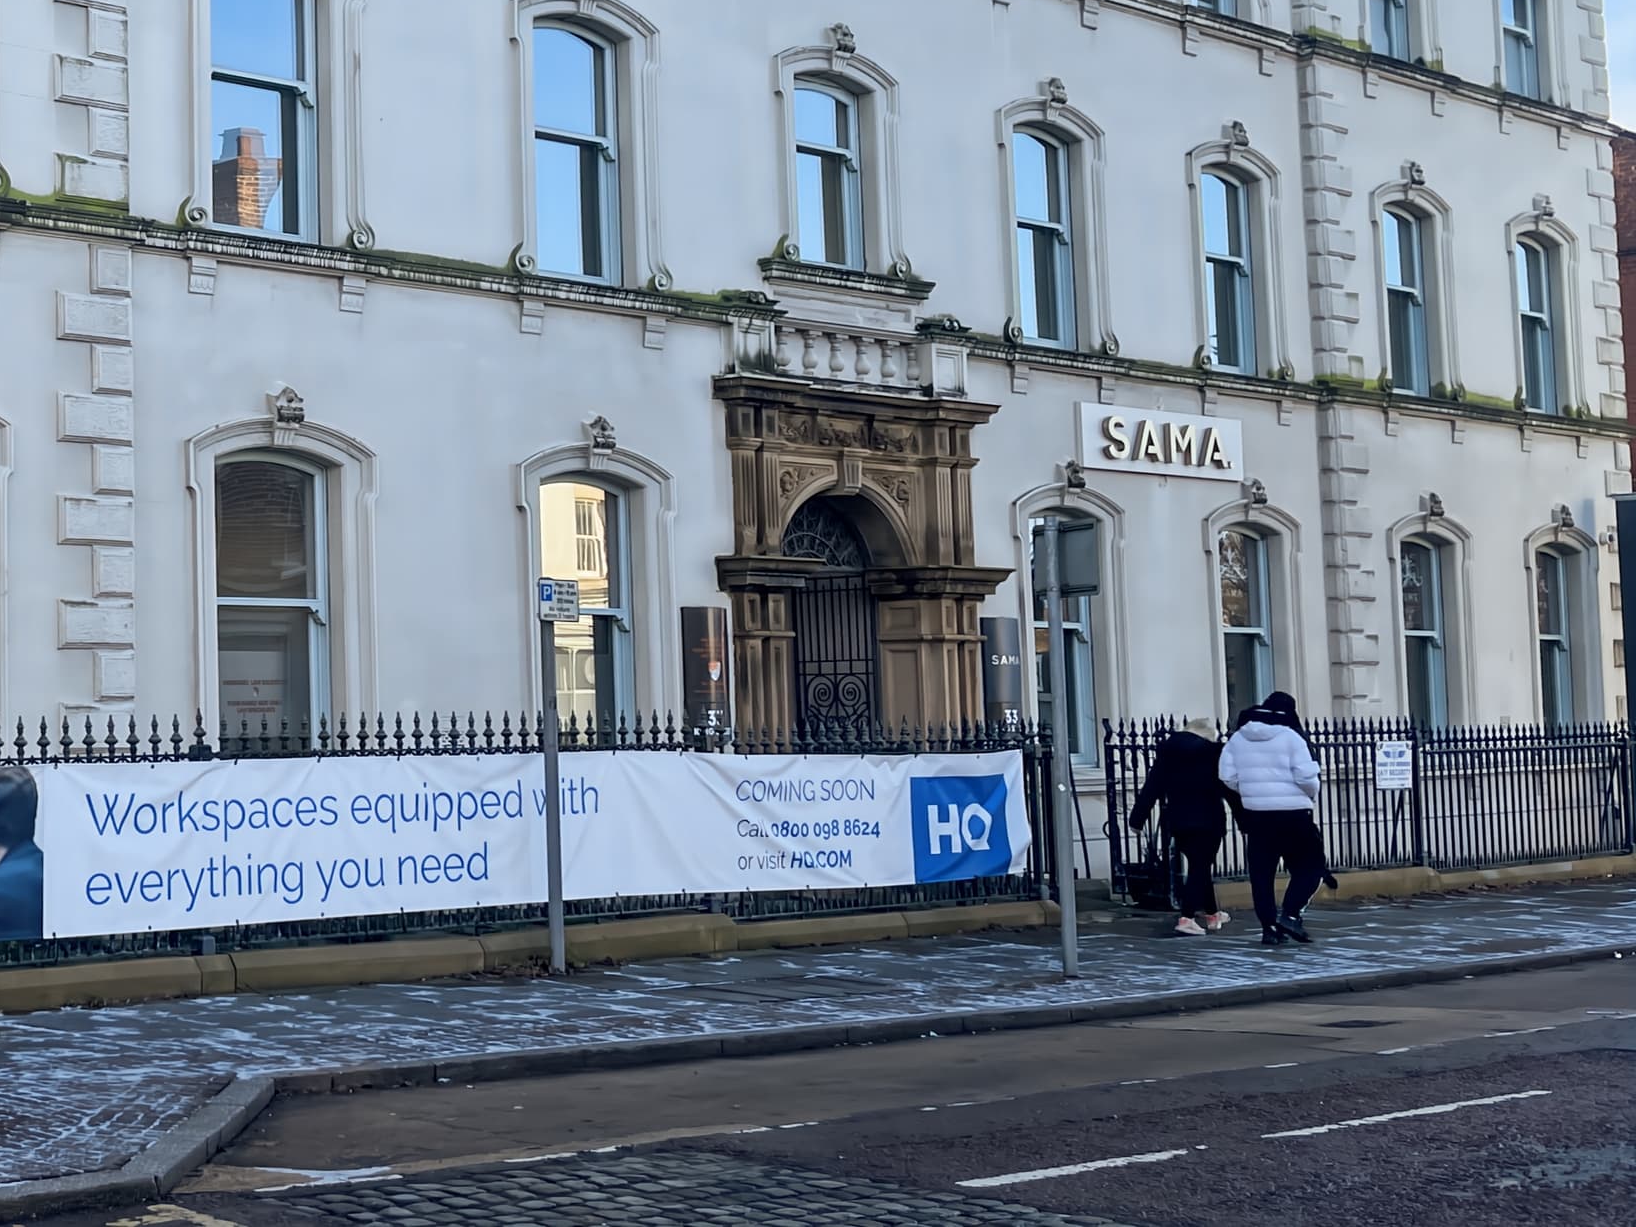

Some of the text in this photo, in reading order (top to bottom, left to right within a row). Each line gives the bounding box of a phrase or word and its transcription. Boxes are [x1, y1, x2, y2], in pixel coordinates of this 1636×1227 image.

[1004, 709, 1019, 724] 33
[736, 779, 875, 802] COMING SOON
[85, 789, 339, 843] Workspaces
[350, 779, 524, 834] equipped
[771, 821, 809, 838] 0800
[814, 819, 840, 840] 098
[844, 819, 880, 839] 8624
[927, 802, 993, 855] HQ
[738, 855, 753, 870] or
[757, 852, 786, 870] visit
[85, 841, 489, 912] everything you need
